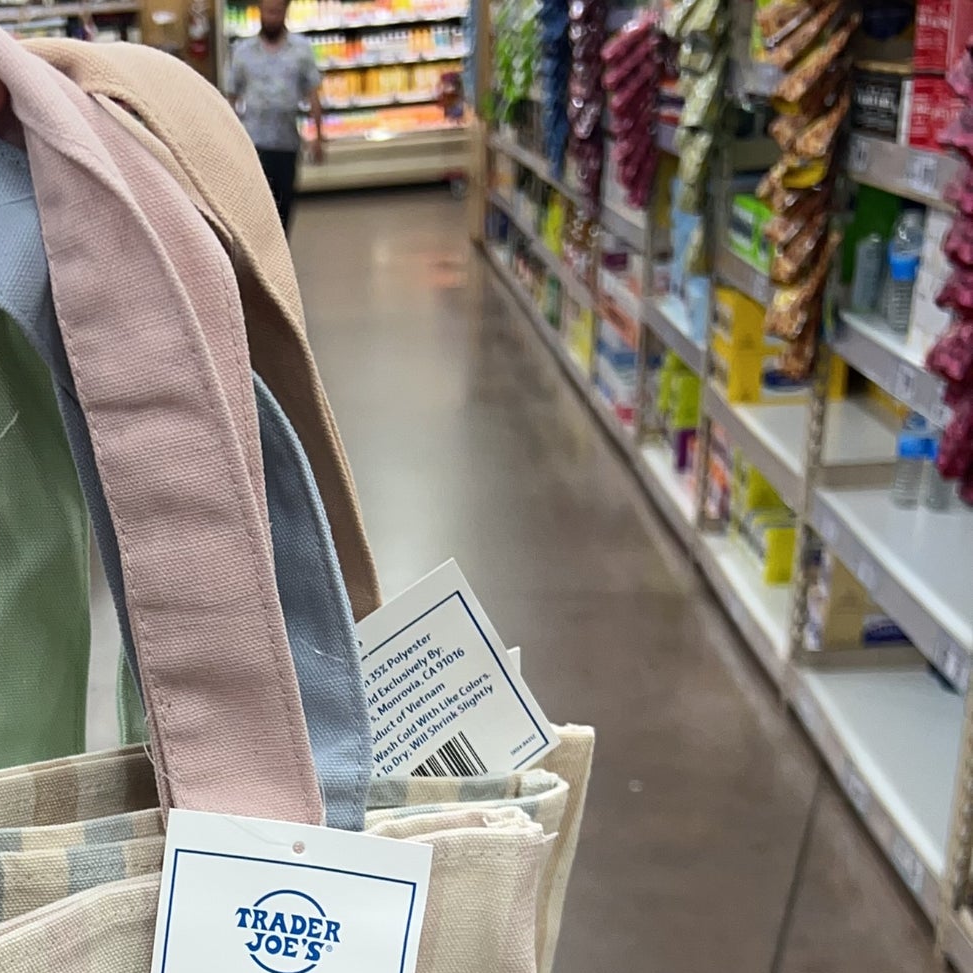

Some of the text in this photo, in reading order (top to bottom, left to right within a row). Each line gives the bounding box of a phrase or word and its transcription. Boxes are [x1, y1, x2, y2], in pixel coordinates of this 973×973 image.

[368, 692, 379, 708] ld
[377, 657, 428, 698] Exclusively
[427, 646, 445, 660] By:
[369, 633, 431, 683] 35% Polyester
[377, 680, 425, 716] Monrovia,
[422, 666, 438, 680] CA
[435, 647, 465, 671] 91016
[372, 683, 446, 745] oduct of Vietnam
[373, 673, 492, 763] Wash Cold With Like Colors.
[381, 764, 393, 776] To
[409, 733, 429, 751] Will
[427, 710, 459, 737] Shrink
[457, 684, 494, 714] Slightly
[235, 907, 342, 944] TRADER
